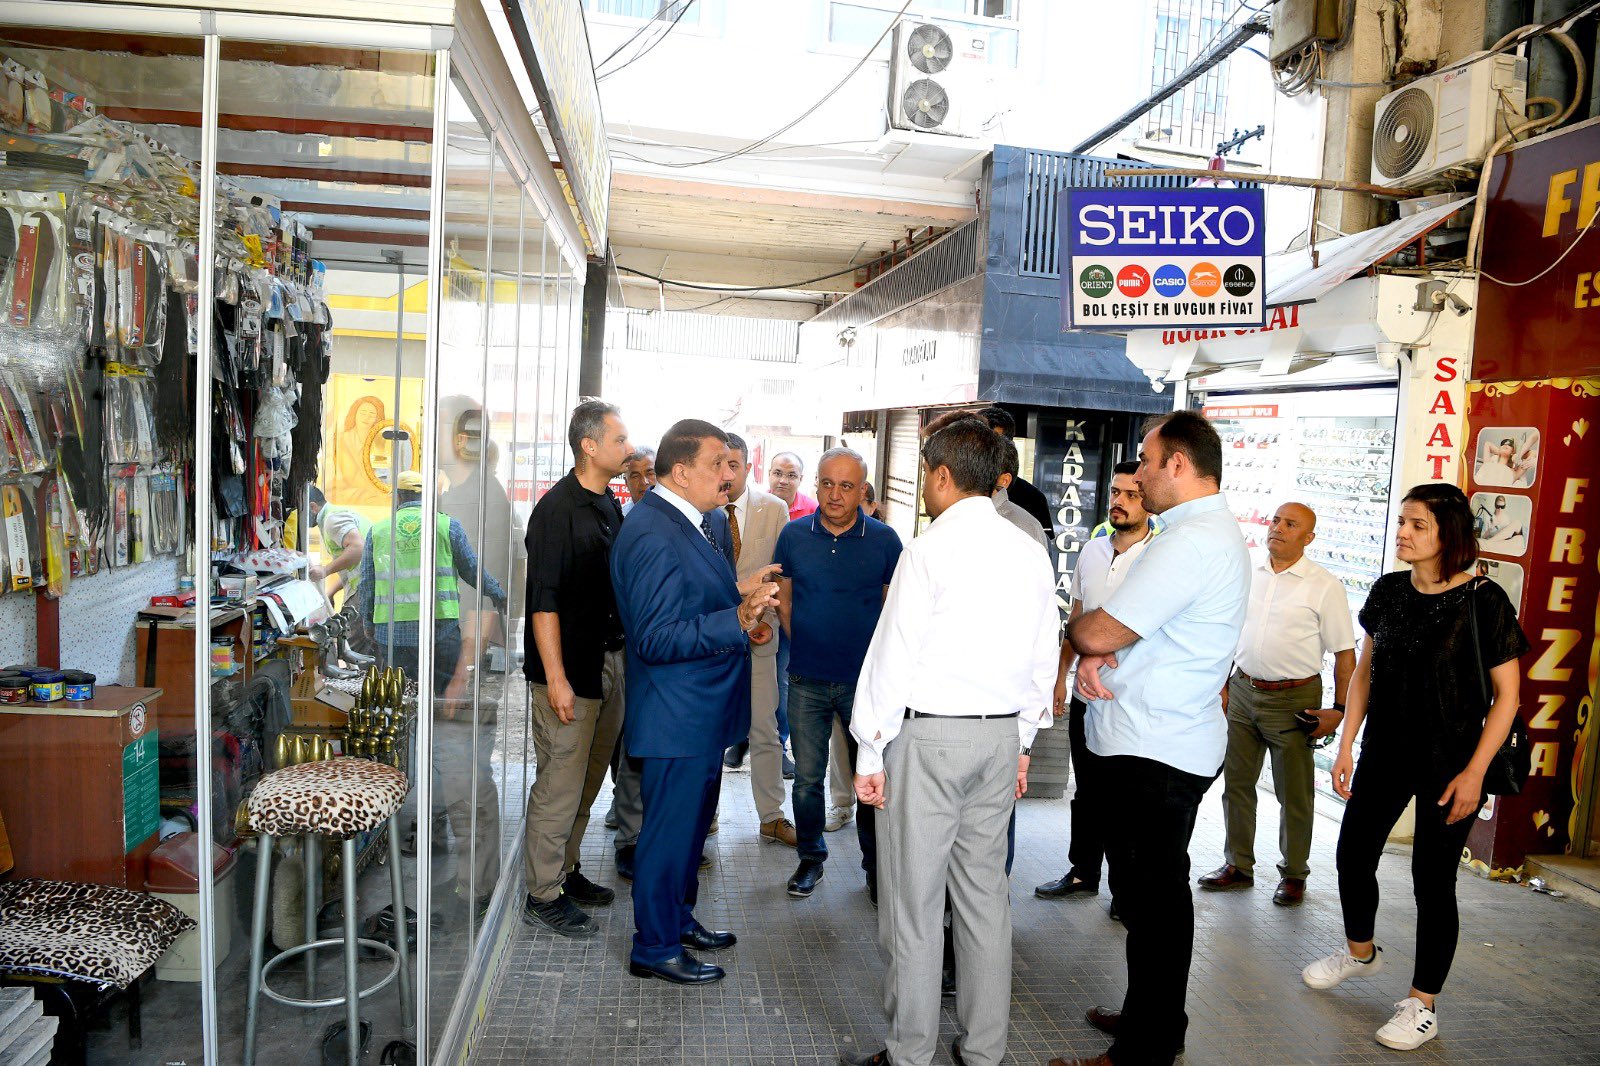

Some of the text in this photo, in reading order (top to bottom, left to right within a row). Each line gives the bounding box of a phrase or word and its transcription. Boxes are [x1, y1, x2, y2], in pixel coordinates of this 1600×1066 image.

[1079, 204, 1255, 246] SEIKO
[1081, 281, 1113, 289] ORIENT
[1119, 279, 1141, 287] PUMA
[1155, 278, 1185, 287] CASIO
[1083, 300, 1254, 319] BOL ÇEŞİT EN UYGUN FİYAT
[1425, 357, 1458, 480] SAAT
[1526, 477, 1590, 777] FREZZA
